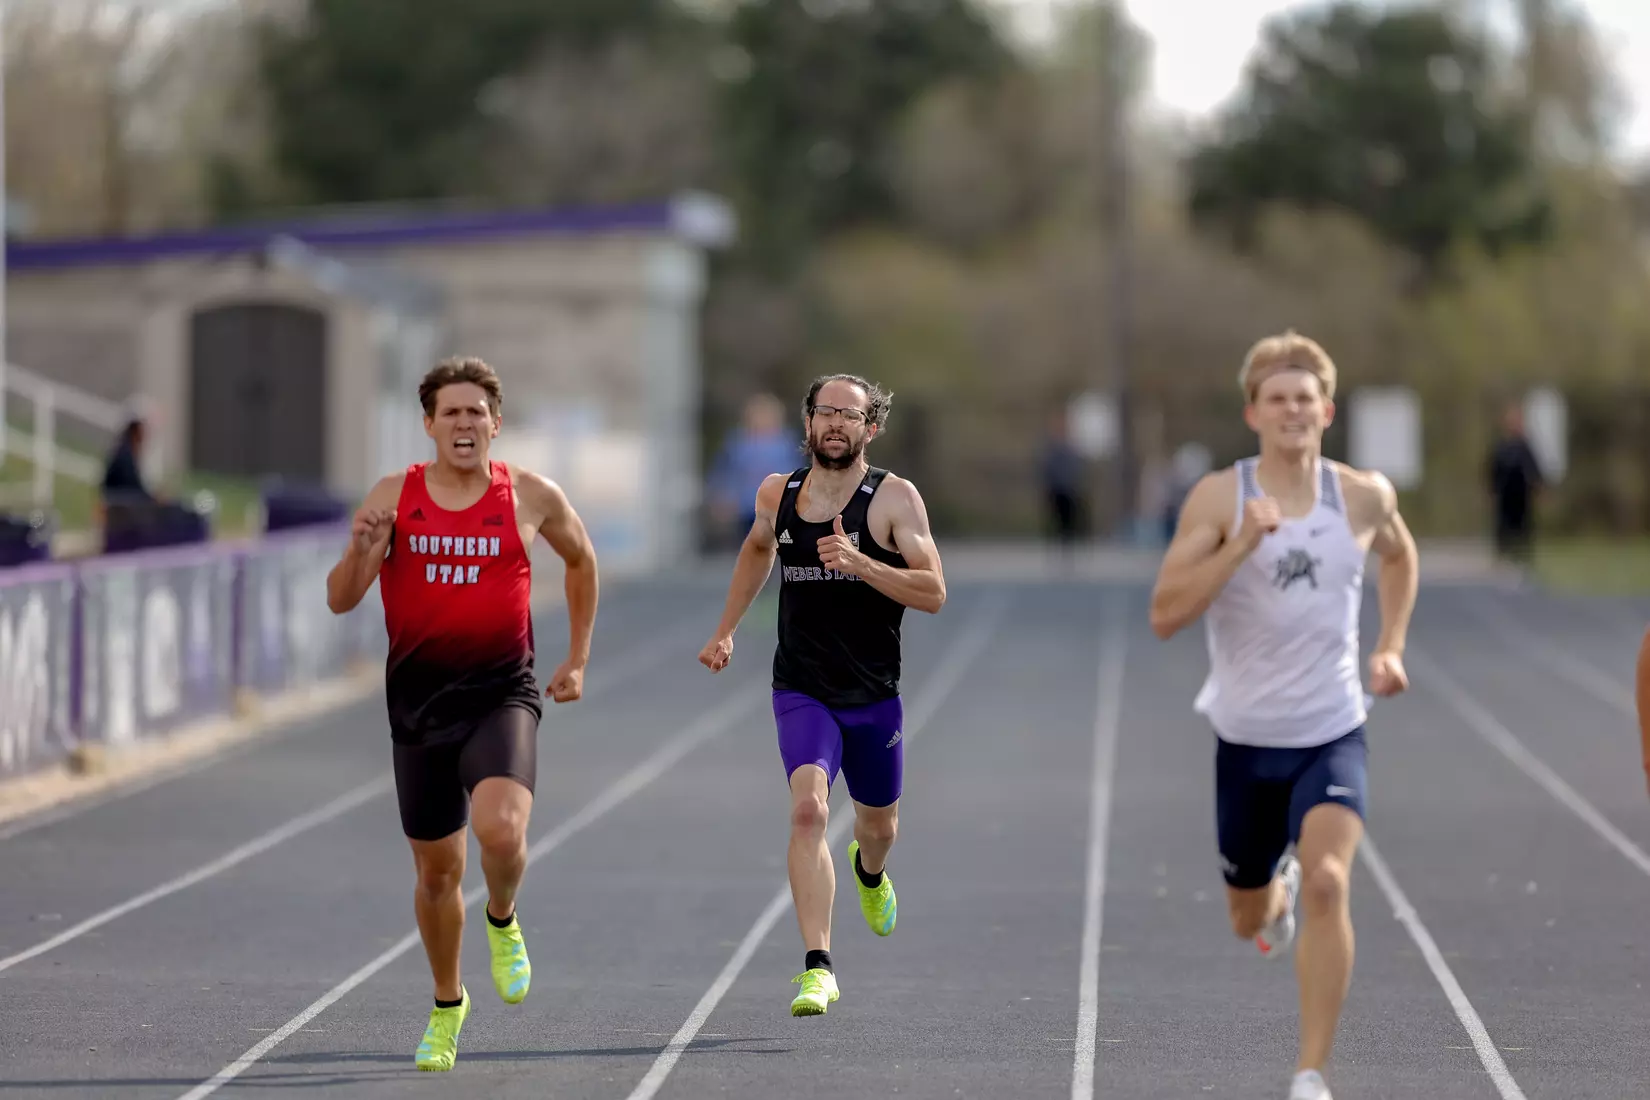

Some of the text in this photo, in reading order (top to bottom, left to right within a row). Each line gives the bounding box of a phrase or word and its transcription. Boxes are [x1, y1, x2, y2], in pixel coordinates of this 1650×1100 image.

[408, 534, 501, 556] SOUTHERN
[425, 563, 480, 584] UTAH
[783, 565, 865, 582] WEBER STA
